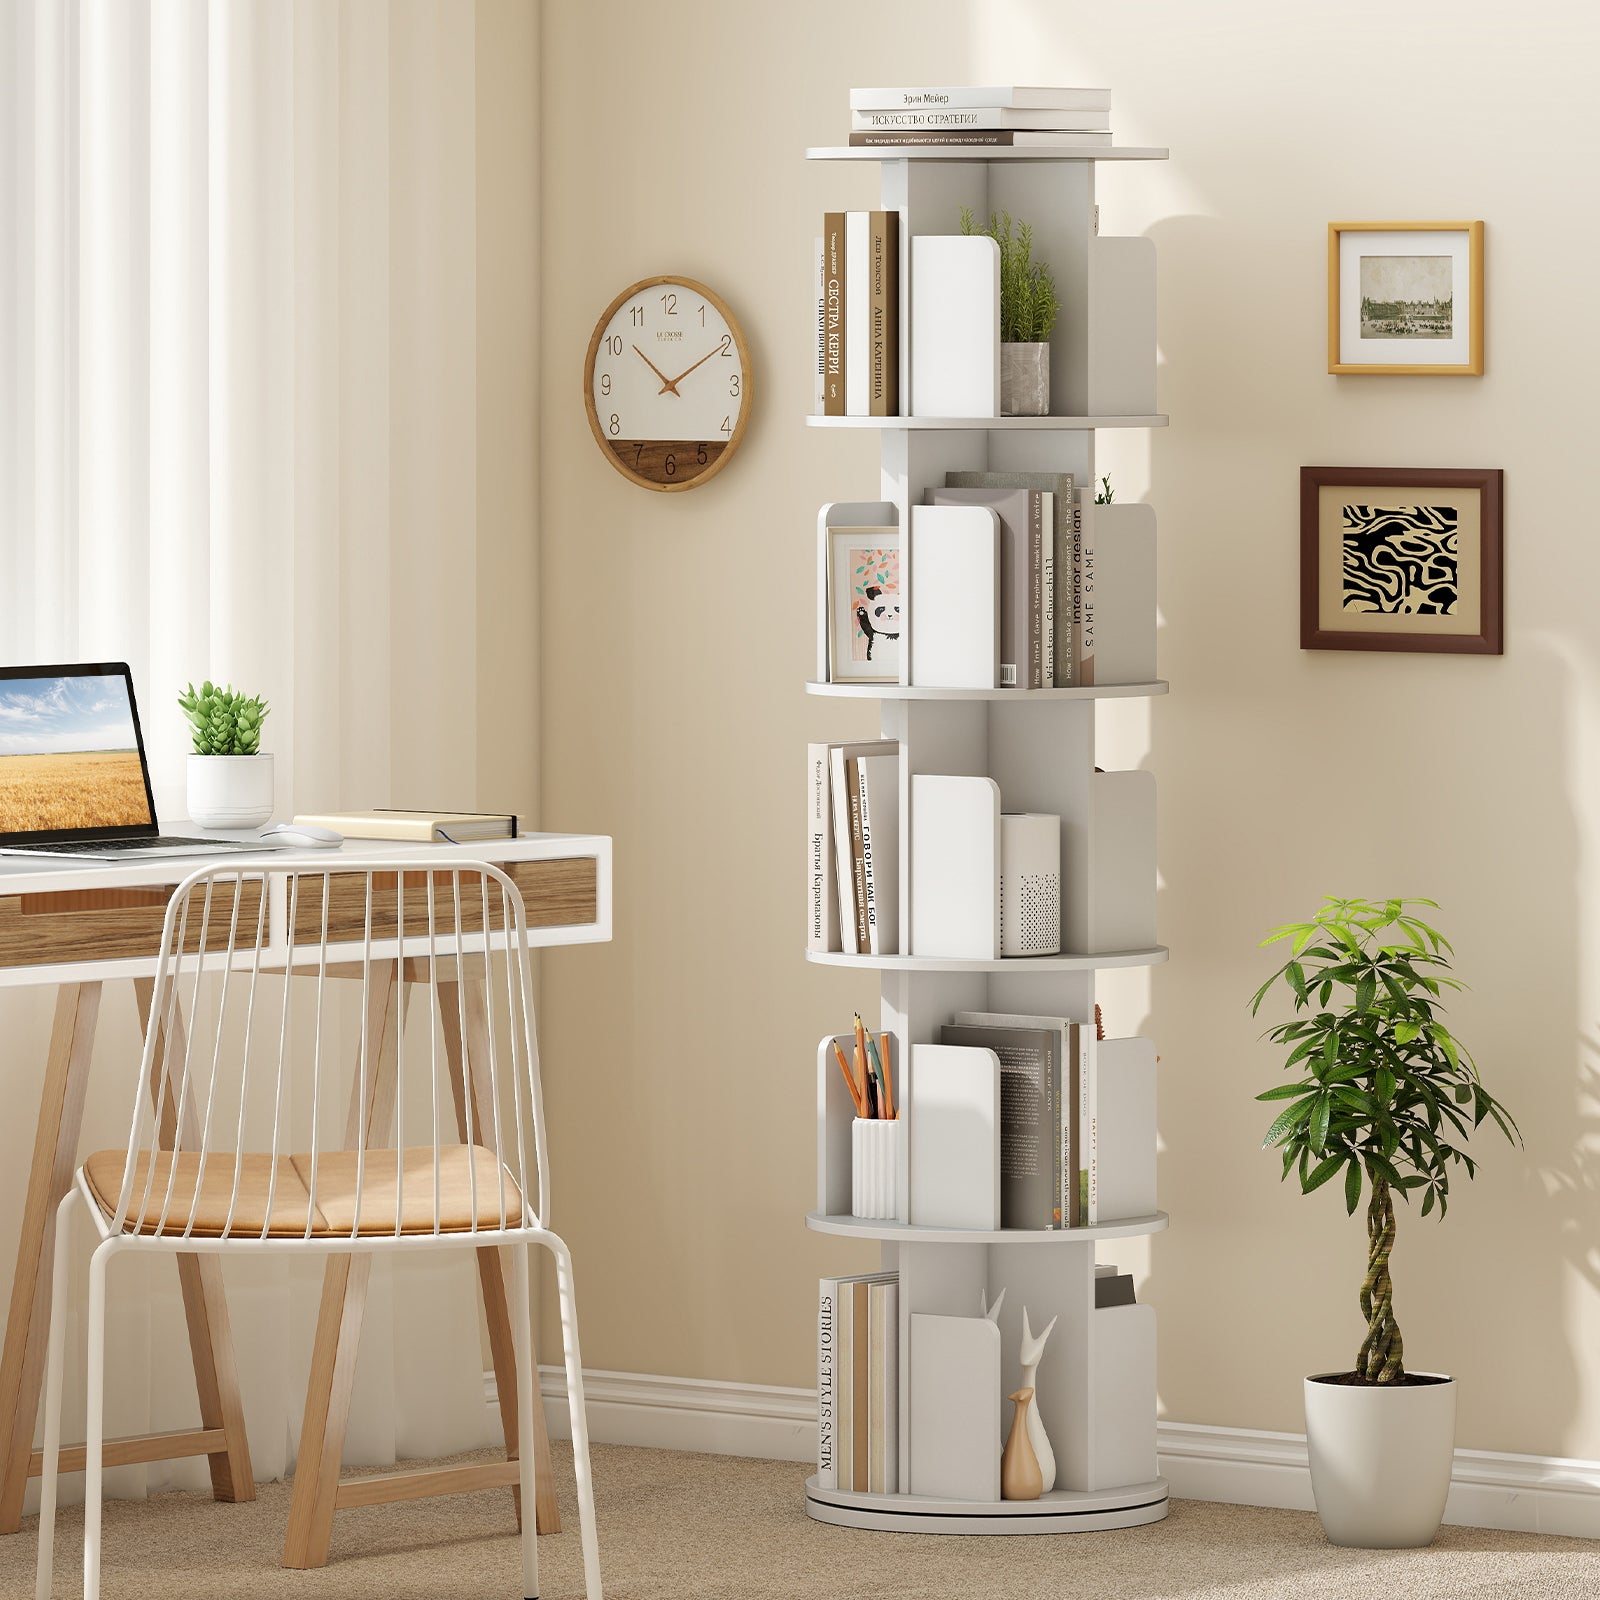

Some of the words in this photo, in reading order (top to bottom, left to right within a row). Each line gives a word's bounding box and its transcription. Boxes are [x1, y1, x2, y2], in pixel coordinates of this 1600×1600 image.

[903, 93, 922, 105] Эрин
[923, 92, 949, 105] Мейер
[871, 114, 925, 125] ИСКУССТВО
[926, 113, 978, 124] СТРАТЕГИИ
[660, 294, 678, 315] 12
[828, 279, 840, 330] СЕСТРА
[629, 306, 644, 327] 11
[697, 305, 705, 328] 1
[605, 335, 623, 356] 10
[720, 334, 732, 357] 2
[828, 332, 840, 376] КЕРРИ
[601, 374, 611, 396] 9
[729, 375, 740, 397] 3
[609, 413, 620, 436] 8
[720, 415, 732, 437] 4
[633, 443, 644, 466] 7
[664, 453, 676, 476] 6
[696, 443, 708, 465] 5
[1085, 548, 1094, 593] SAME
[1045, 556, 1054, 621] Churchill
[1085, 603, 1094, 648] SAME
[1046, 628, 1054, 680] Winston
[811, 832, 824, 871] Братья
[863, 826, 873, 878] ГОВОРИ
[855, 857, 867, 908] Бархатная
[867, 882, 876, 903] КАК
[811, 873, 824, 939] Карамазовы
[868, 907, 877, 927] БОГ
[858, 909, 868, 942] смерть
[820, 1296, 832, 1364] STORIES
[820, 1367, 832, 1417] STYLE
[820, 1421, 832, 1471] MEN'S
